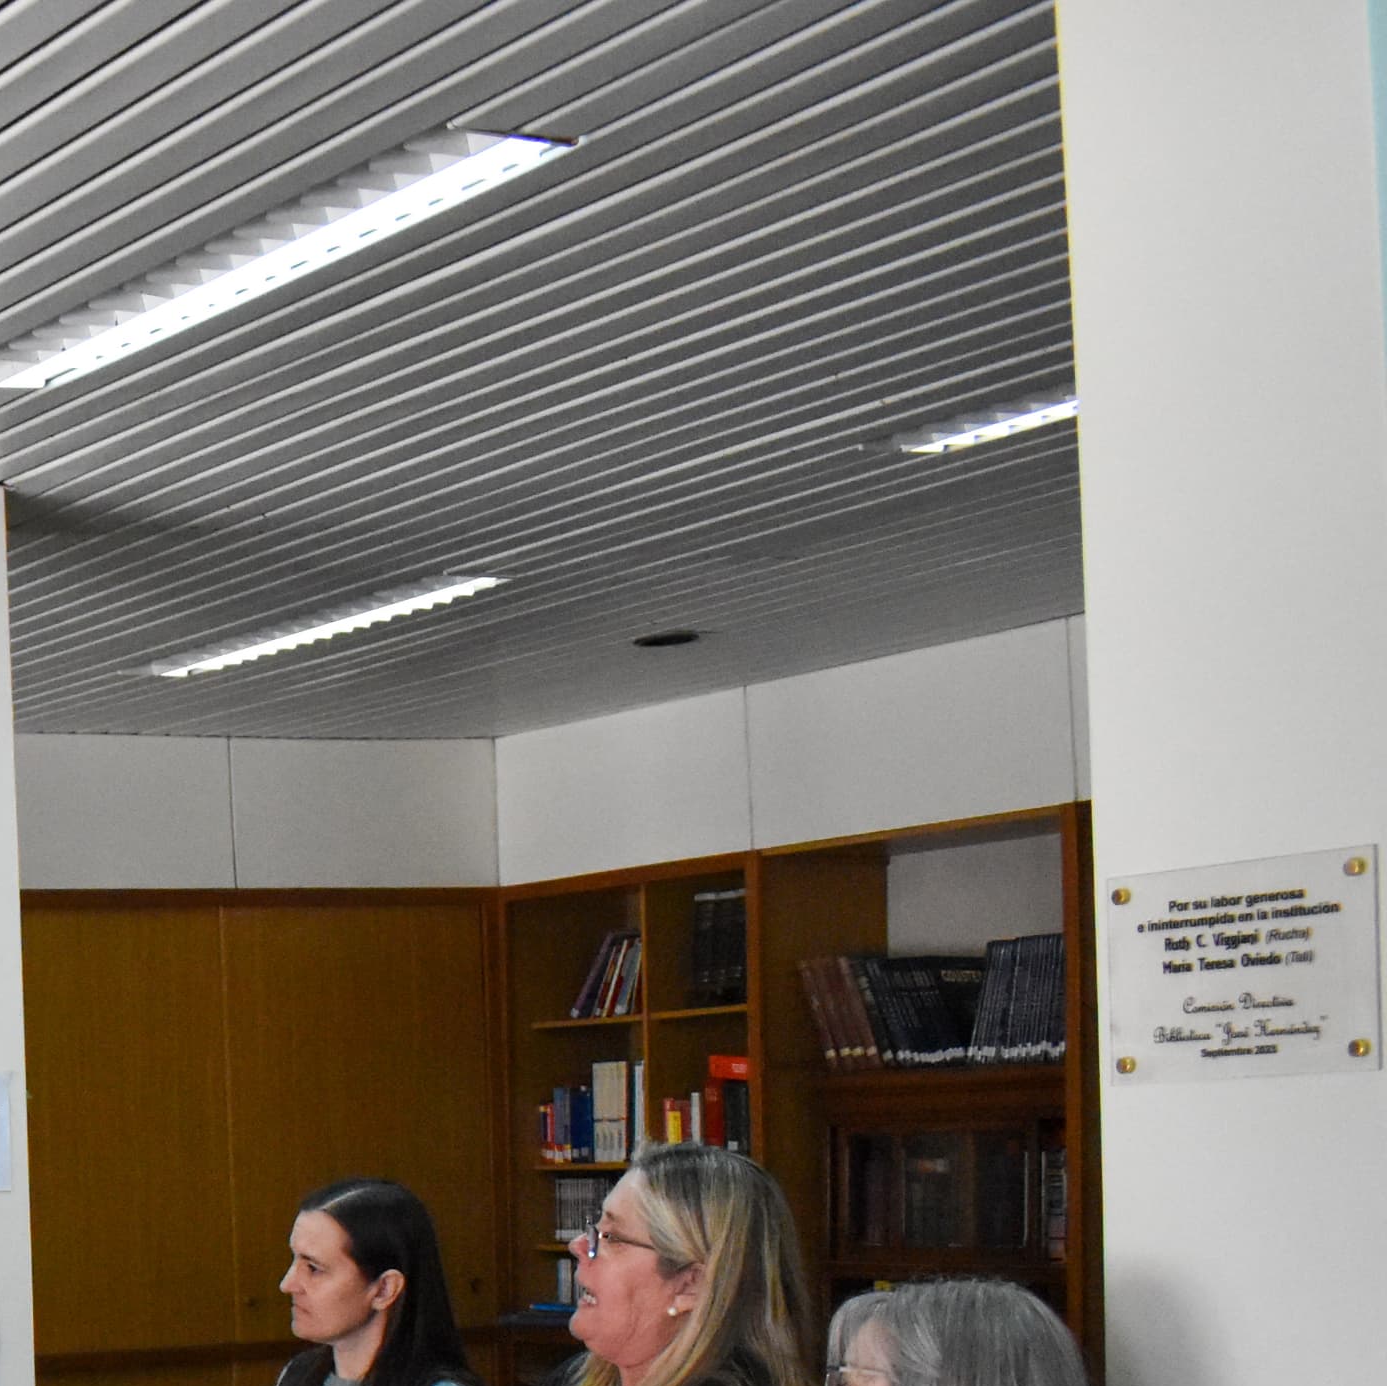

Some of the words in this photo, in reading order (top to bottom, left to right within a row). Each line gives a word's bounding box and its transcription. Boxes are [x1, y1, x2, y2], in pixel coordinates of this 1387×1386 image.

[1169, 900, 1190, 912] Por
[1192, 899, 1208, 910] su
[1210, 895, 1243, 908] labor
[1245, 888, 1304, 907] generosa
[1137, 923, 1144, 933] e
[1238, 912, 1253, 922] en
[1257, 909, 1268, 920] la
[1271, 902, 1340, 919] institución
[1198, 958, 1235, 971] Teresa
[1241, 954, 1281, 968] Oviedo
